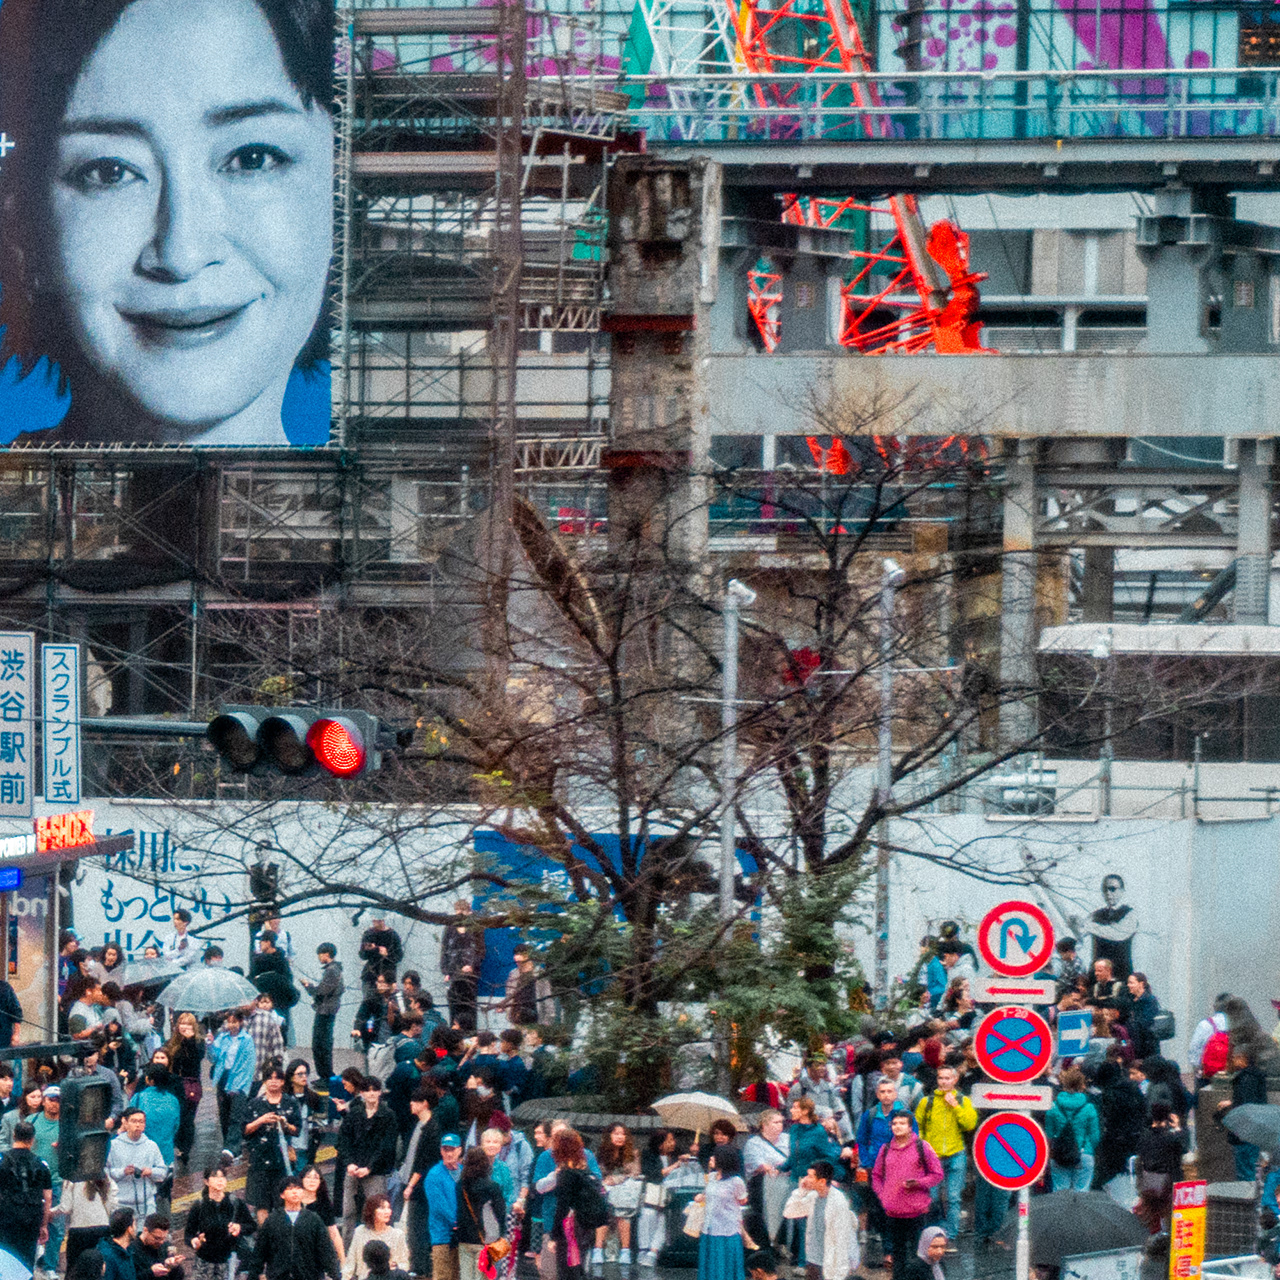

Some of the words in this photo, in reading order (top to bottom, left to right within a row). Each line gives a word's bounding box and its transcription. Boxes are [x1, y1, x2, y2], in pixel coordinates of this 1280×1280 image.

[50, 651, 72, 799] スクランブル式
